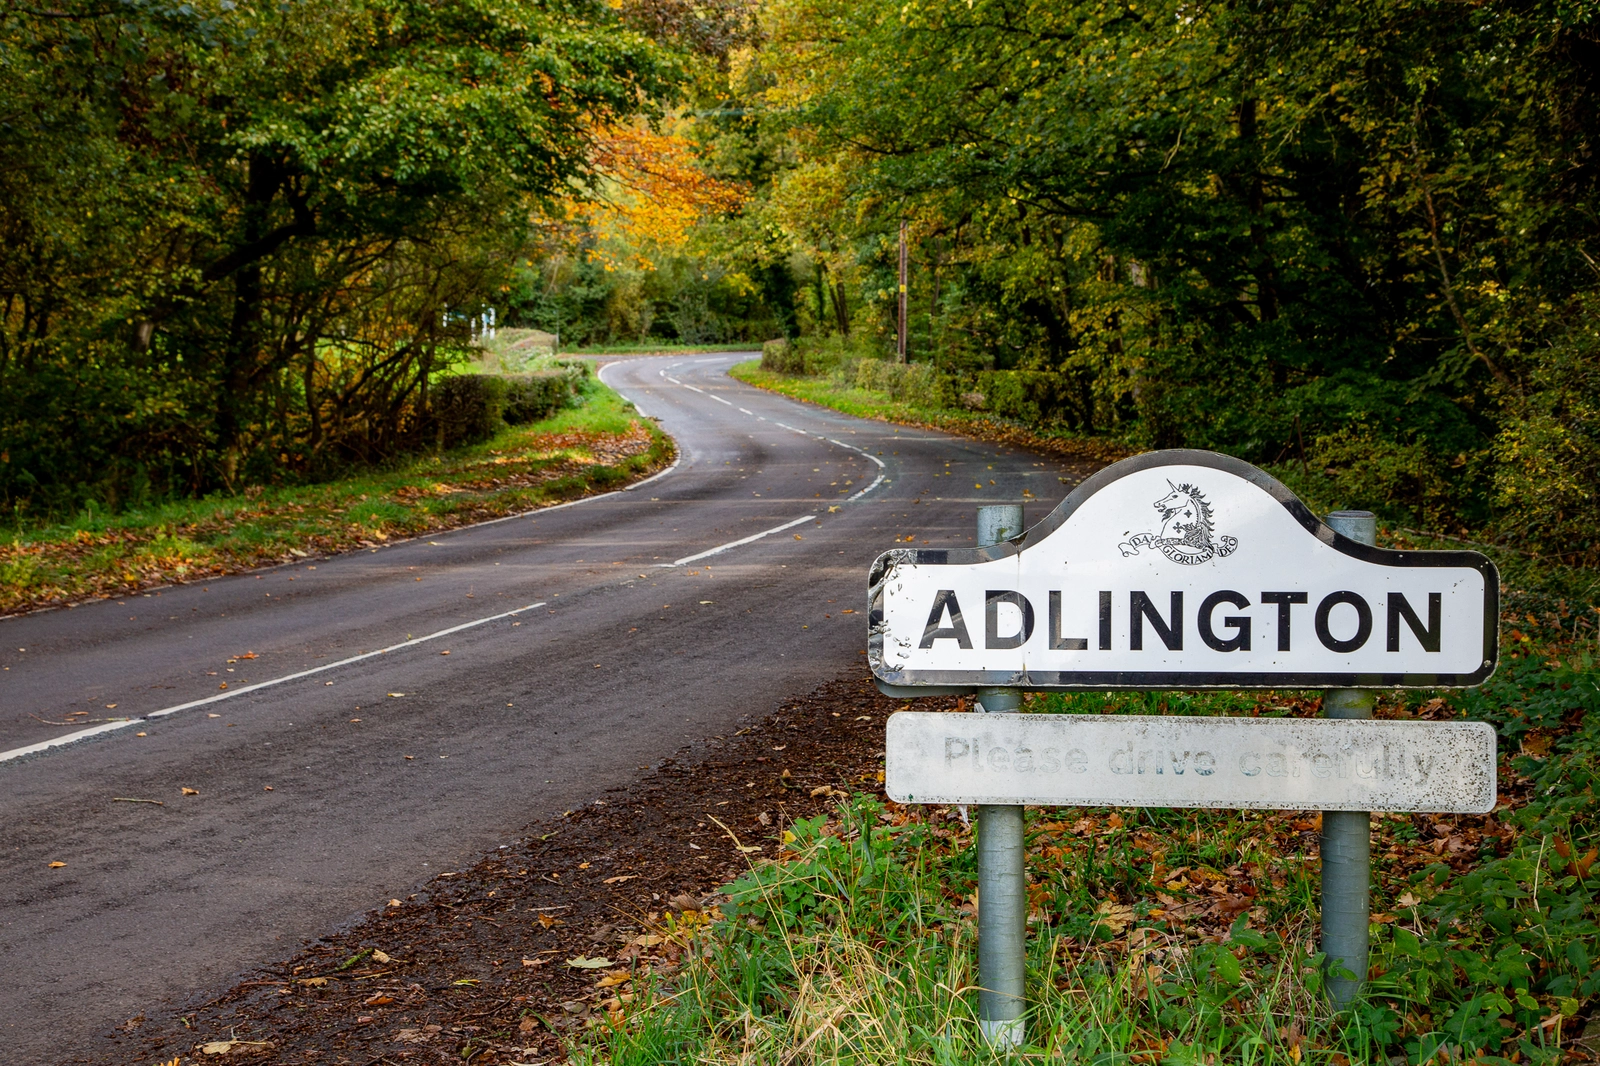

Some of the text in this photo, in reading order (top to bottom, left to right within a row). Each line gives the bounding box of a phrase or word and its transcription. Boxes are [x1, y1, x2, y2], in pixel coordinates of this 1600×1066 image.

[1131, 534, 1237, 565] DA GLORIAM DEO
[918, 589, 1442, 653] ADLINGTON
[944, 736, 1089, 774] Please
[1108, 740, 1216, 776] drive
